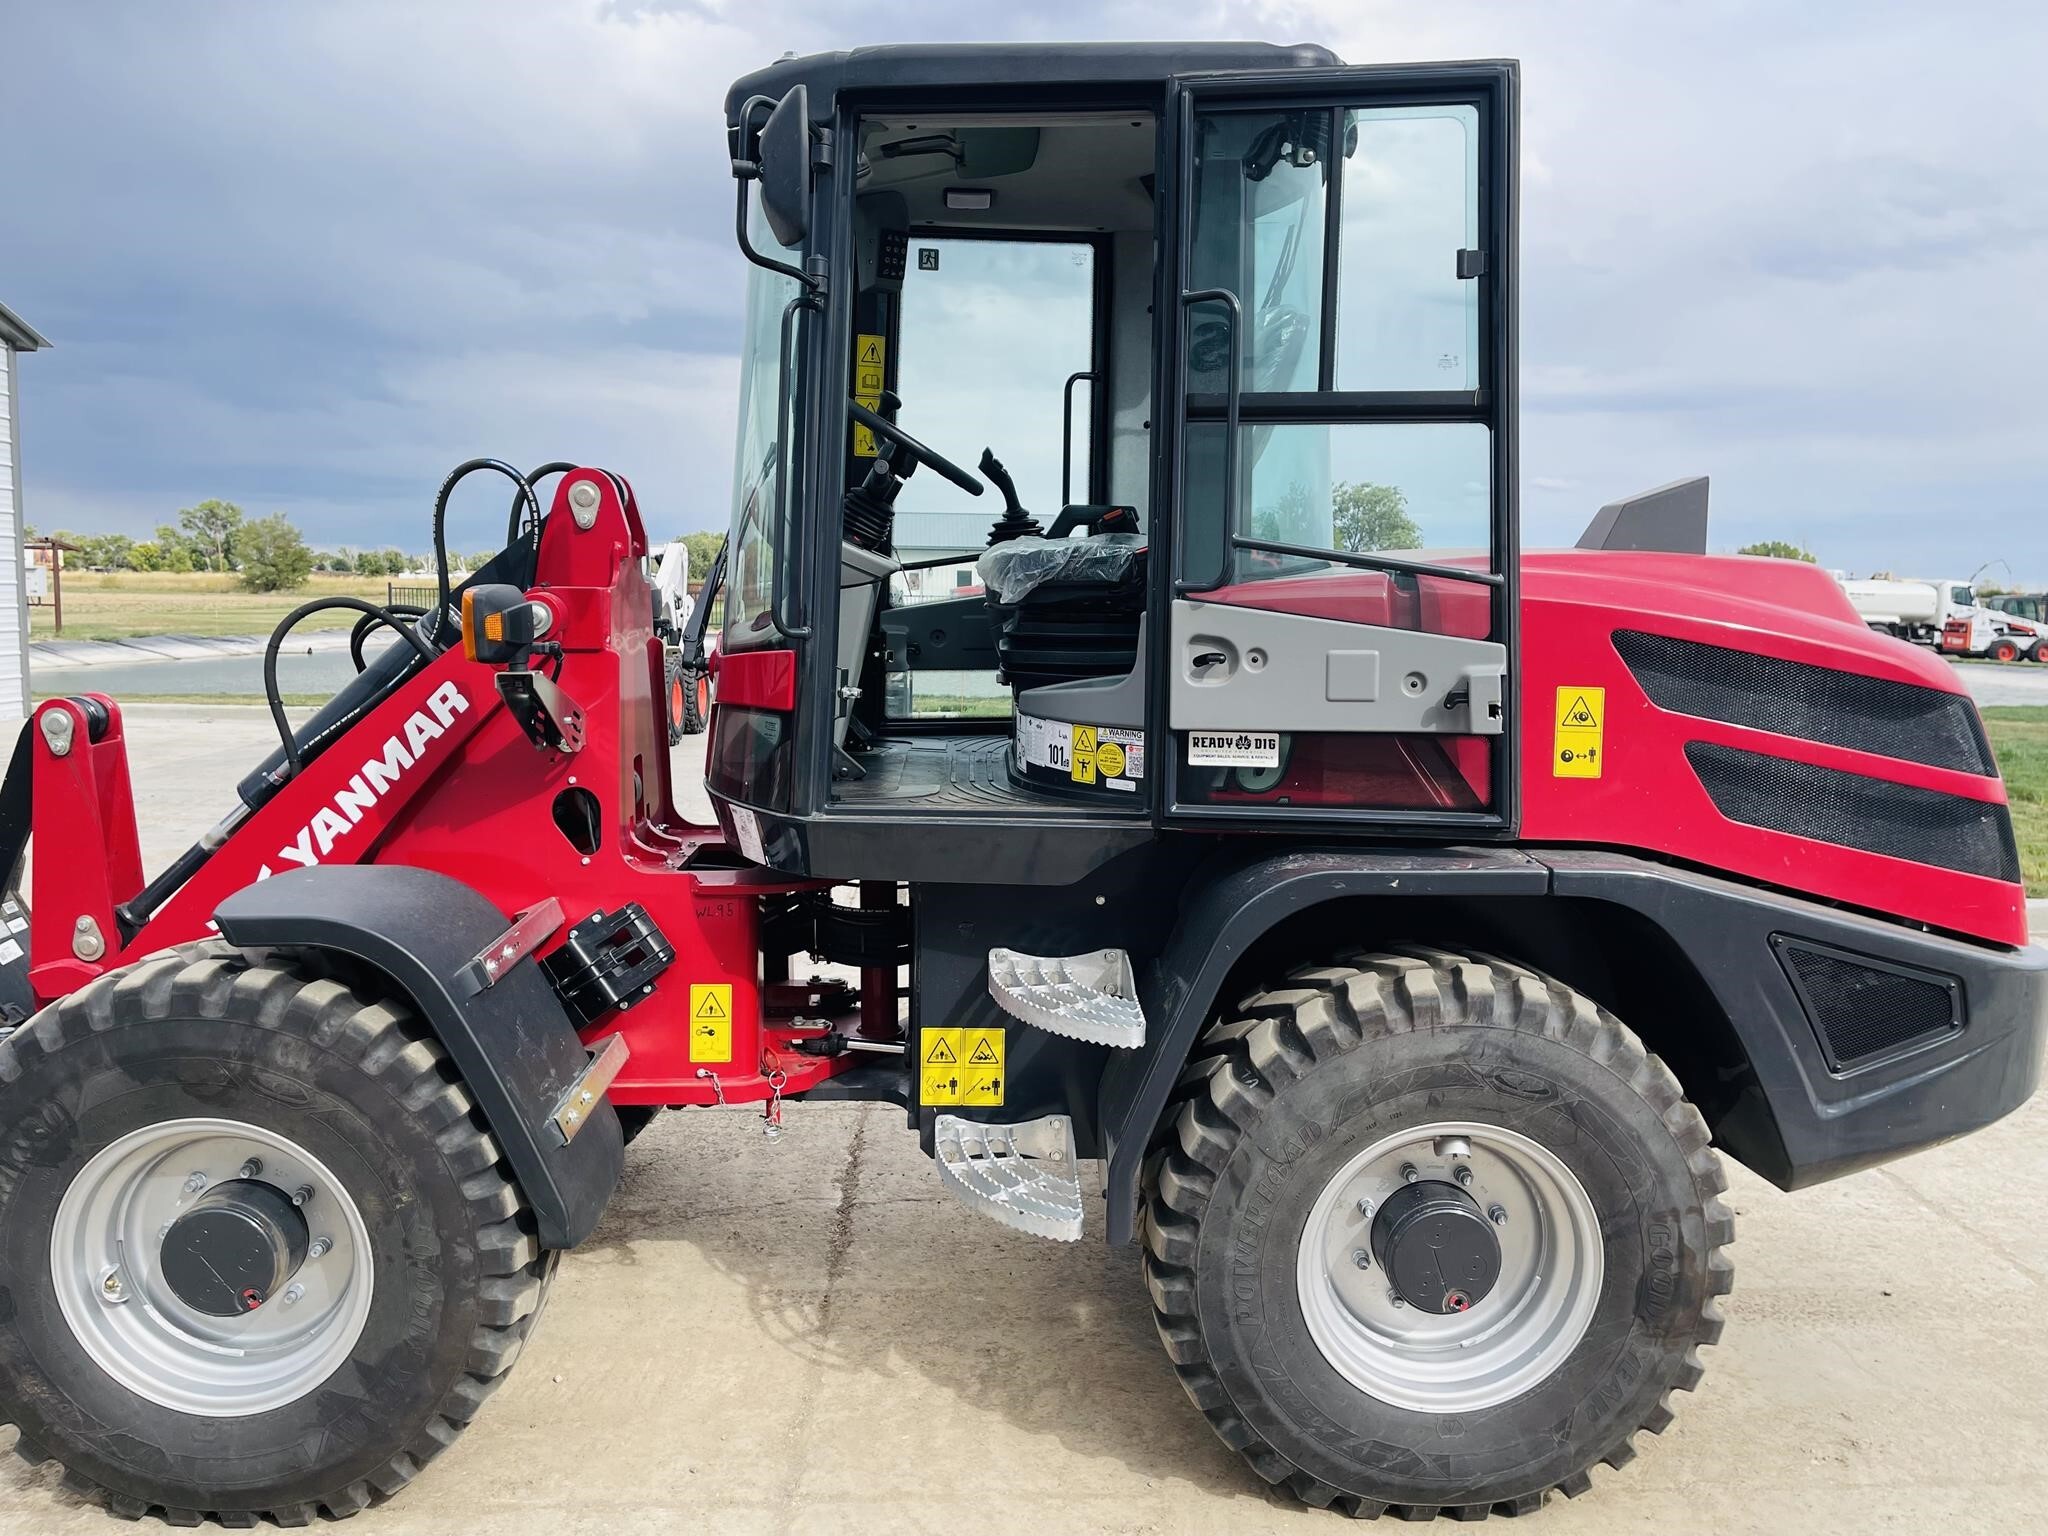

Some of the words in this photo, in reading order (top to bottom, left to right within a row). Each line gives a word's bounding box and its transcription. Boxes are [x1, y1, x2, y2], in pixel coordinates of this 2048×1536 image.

[1108, 728, 1142, 739] WARNING
[1192, 736, 1233, 749] READY
[1254, 738, 1276, 750] DIG
[1048, 743, 1064, 766] 101
[278, 680, 470, 866] YANMAR
